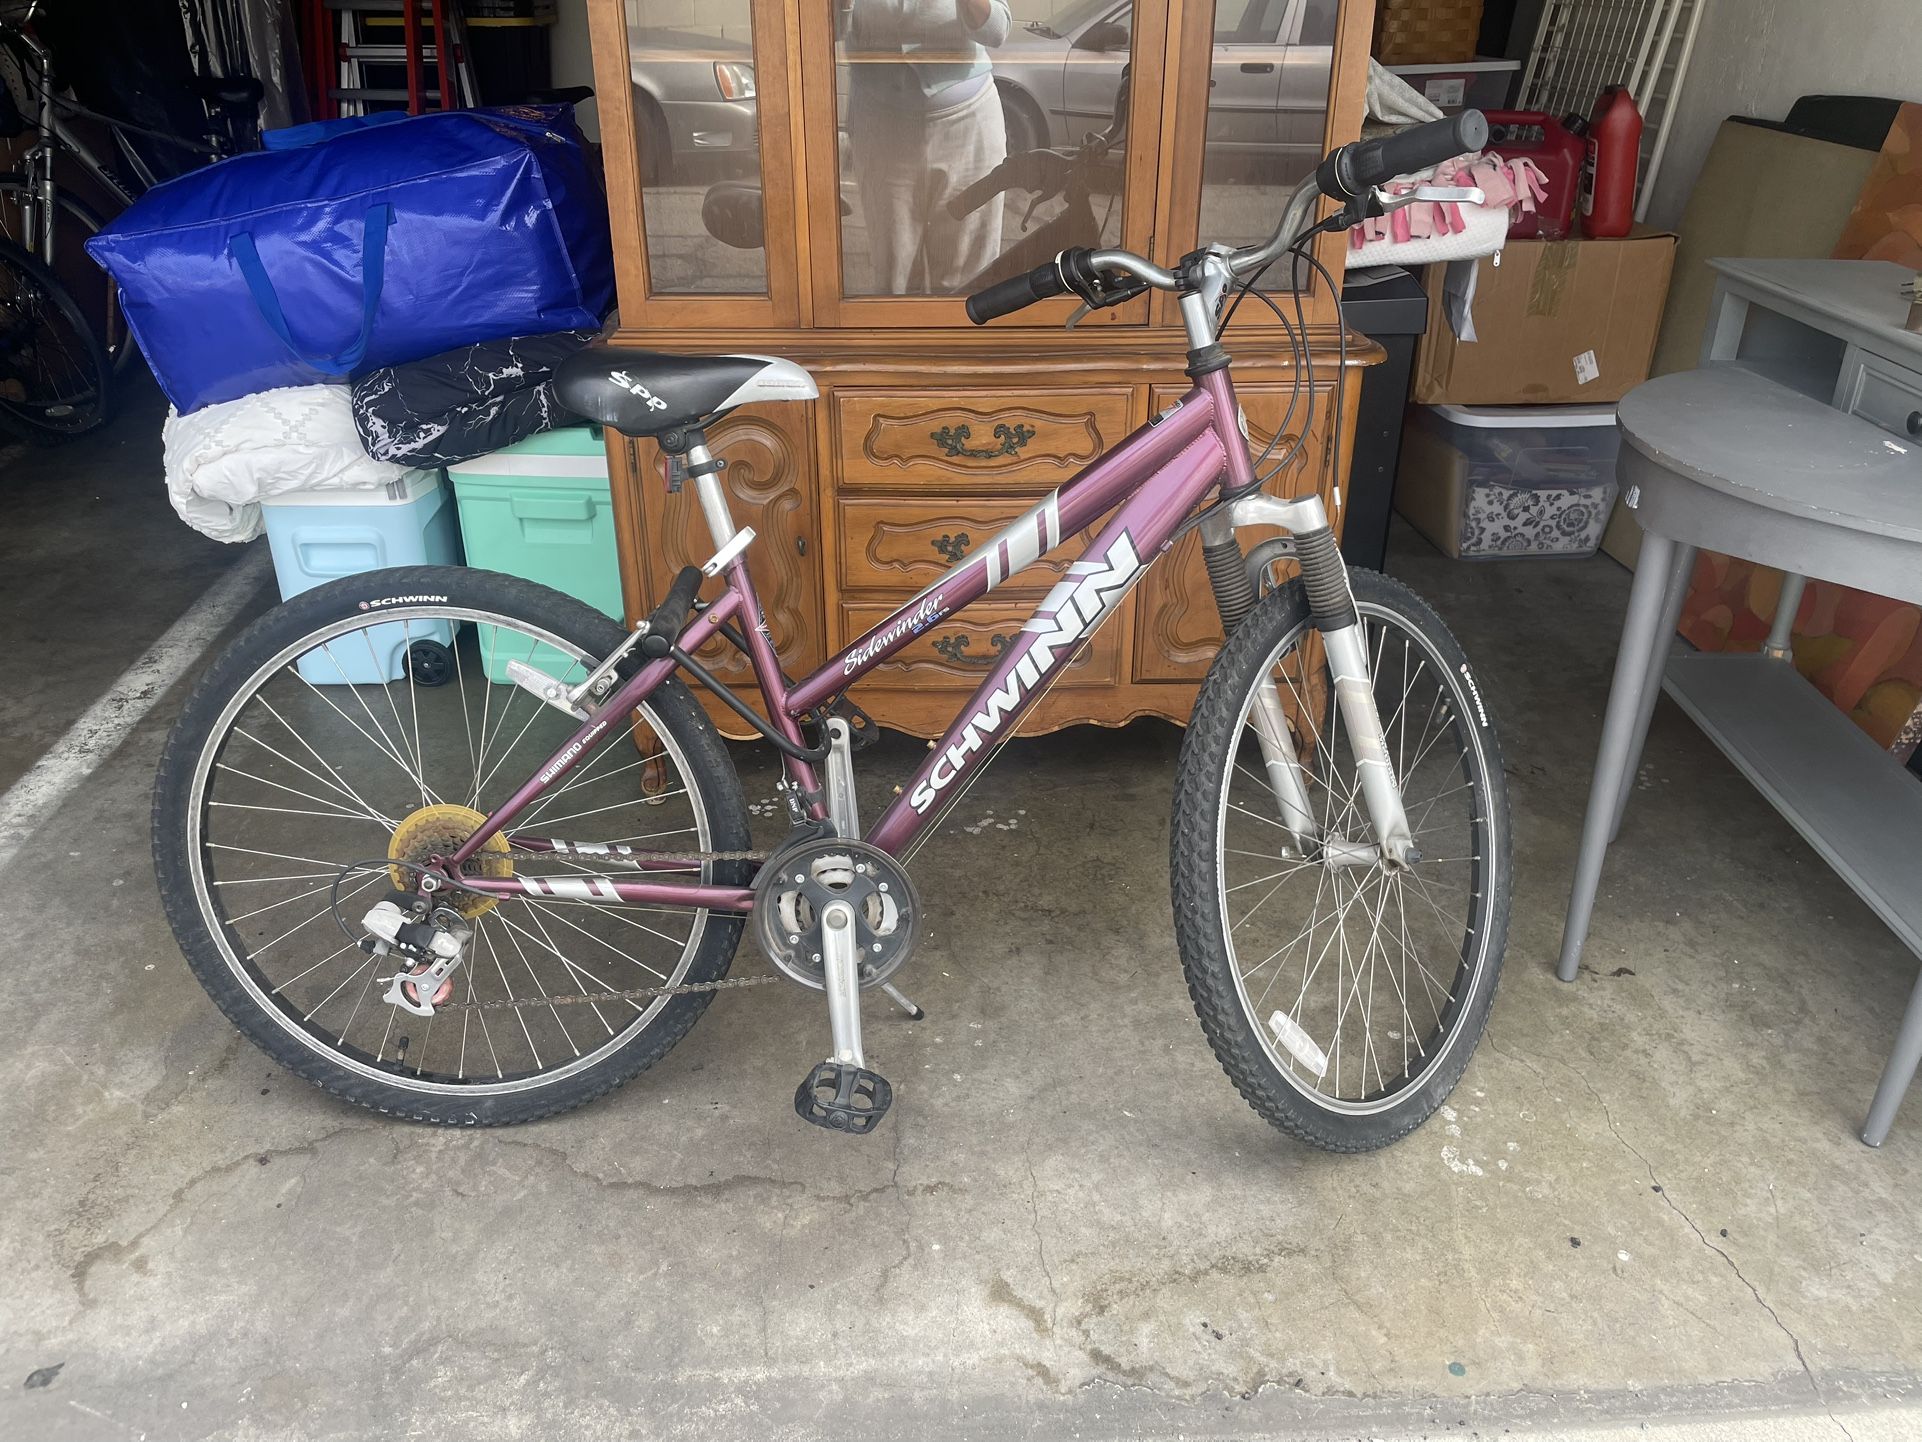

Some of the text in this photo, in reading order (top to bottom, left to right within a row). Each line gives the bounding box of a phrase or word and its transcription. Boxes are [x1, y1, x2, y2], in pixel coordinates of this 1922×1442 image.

[370, 595, 448, 608] SCHWINN
[844, 593, 943, 676] Sidewinder
[909, 526, 1141, 816] SCHWINN
[1464, 672, 1488, 727] SCHWINN
[540, 742, 582, 784] SHIMANO
